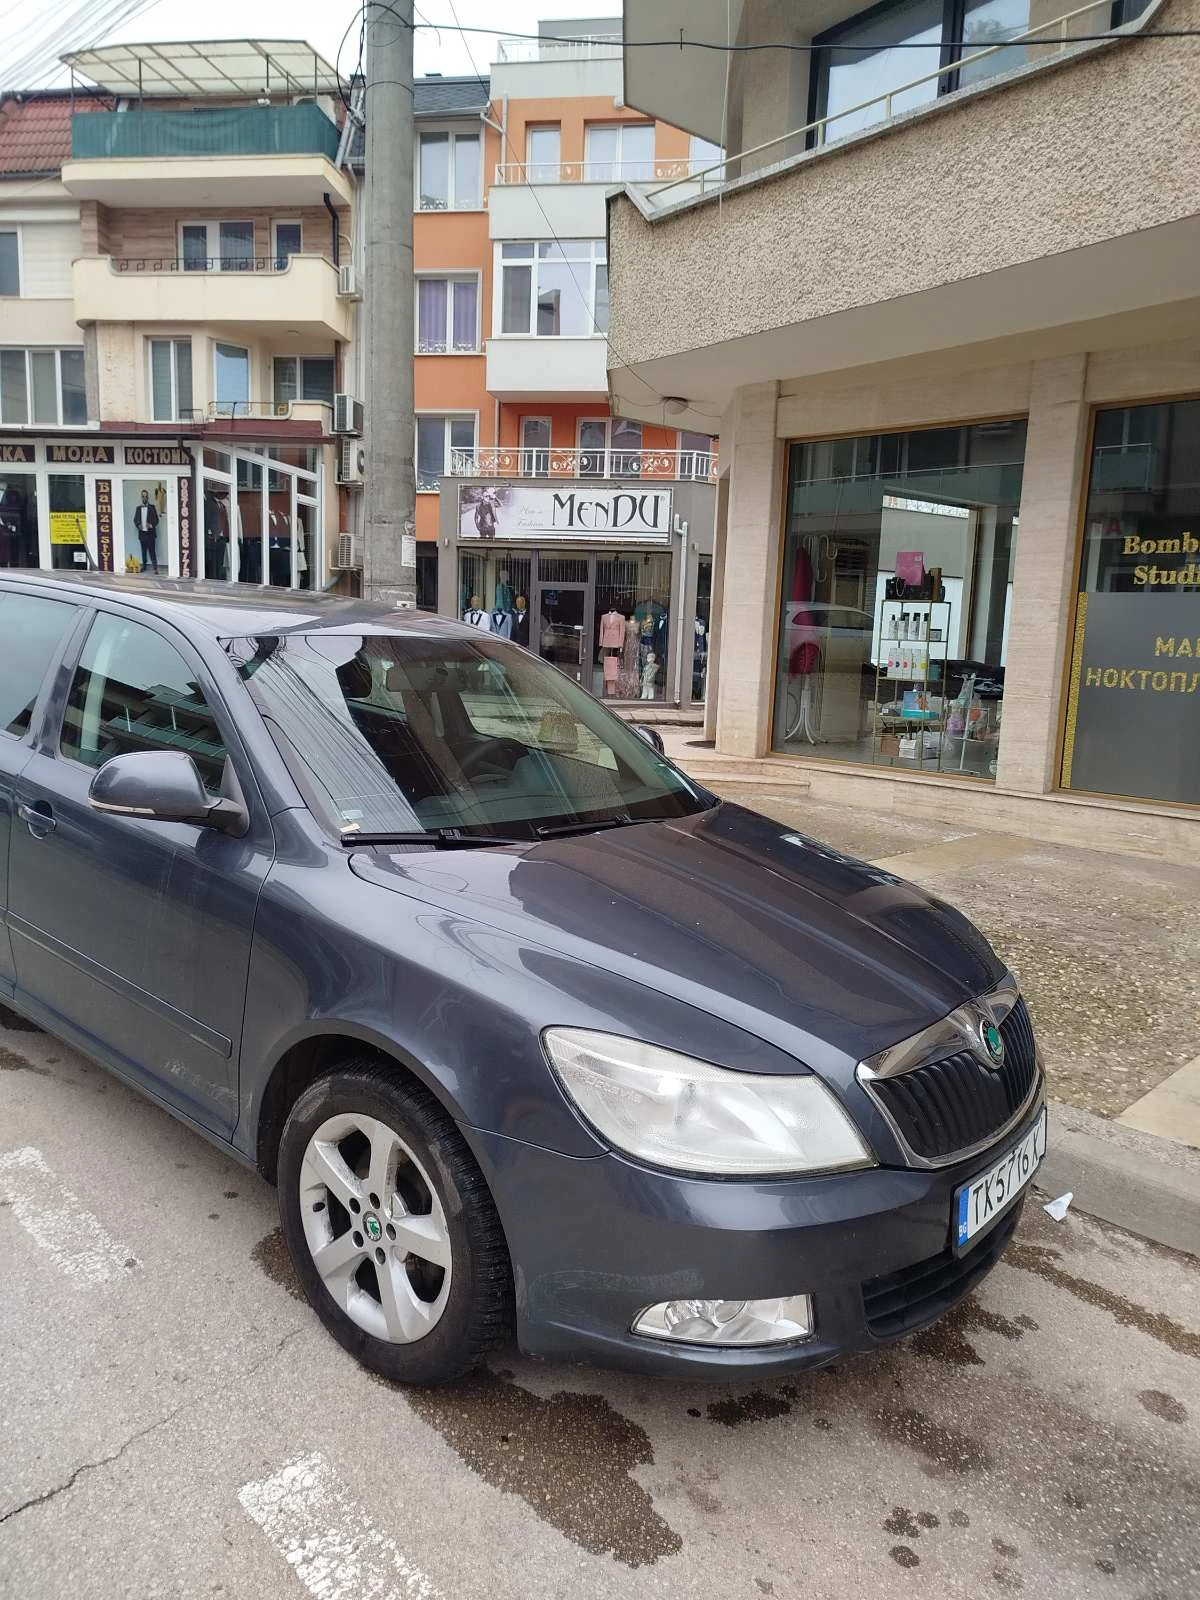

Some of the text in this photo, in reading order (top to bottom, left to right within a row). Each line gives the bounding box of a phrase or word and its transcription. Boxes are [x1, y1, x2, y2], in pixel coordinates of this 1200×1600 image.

[0, 446, 26, 461] КА
[52, 446, 108, 464] МОДА
[972, 1117, 1043, 1225] TX5716X
